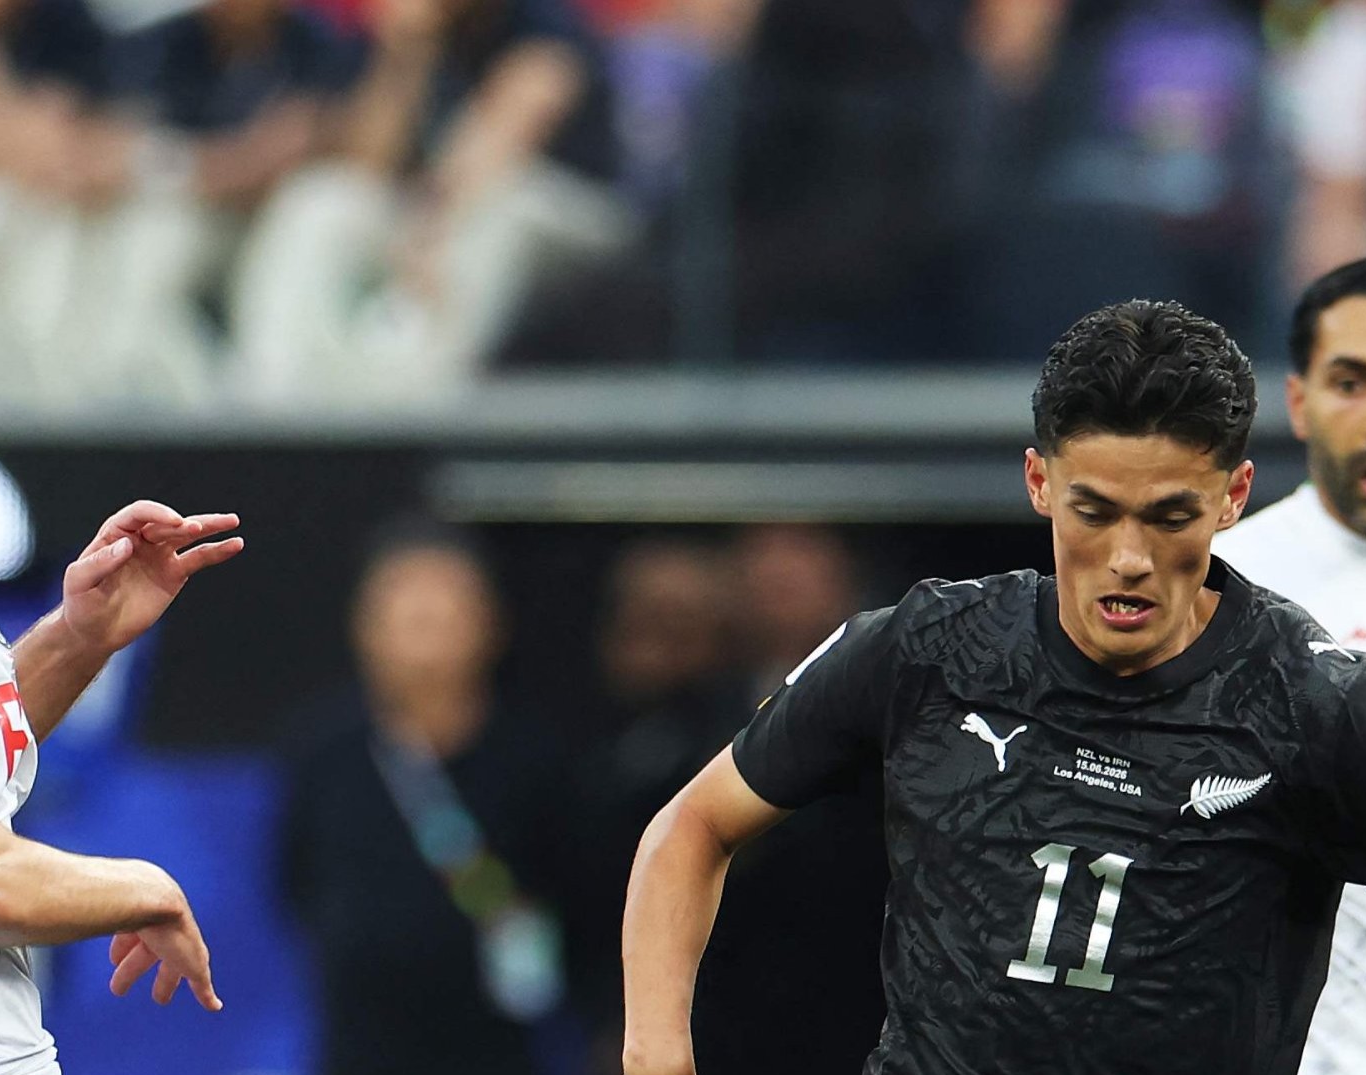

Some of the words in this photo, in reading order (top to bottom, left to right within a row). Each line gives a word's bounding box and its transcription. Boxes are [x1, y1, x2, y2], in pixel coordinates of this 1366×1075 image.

[1076, 748, 1096, 760] NZL
[1099, 755, 1110, 764] vs
[1113, 758, 1130, 768] IRN
[1076, 759, 1127, 779] 15.06.2026
[1054, 766, 1072, 778] Los
[1074, 772, 1117, 791] Angeles,
[1120, 783, 1141, 796] USA
[1007, 843, 1134, 991] 11
